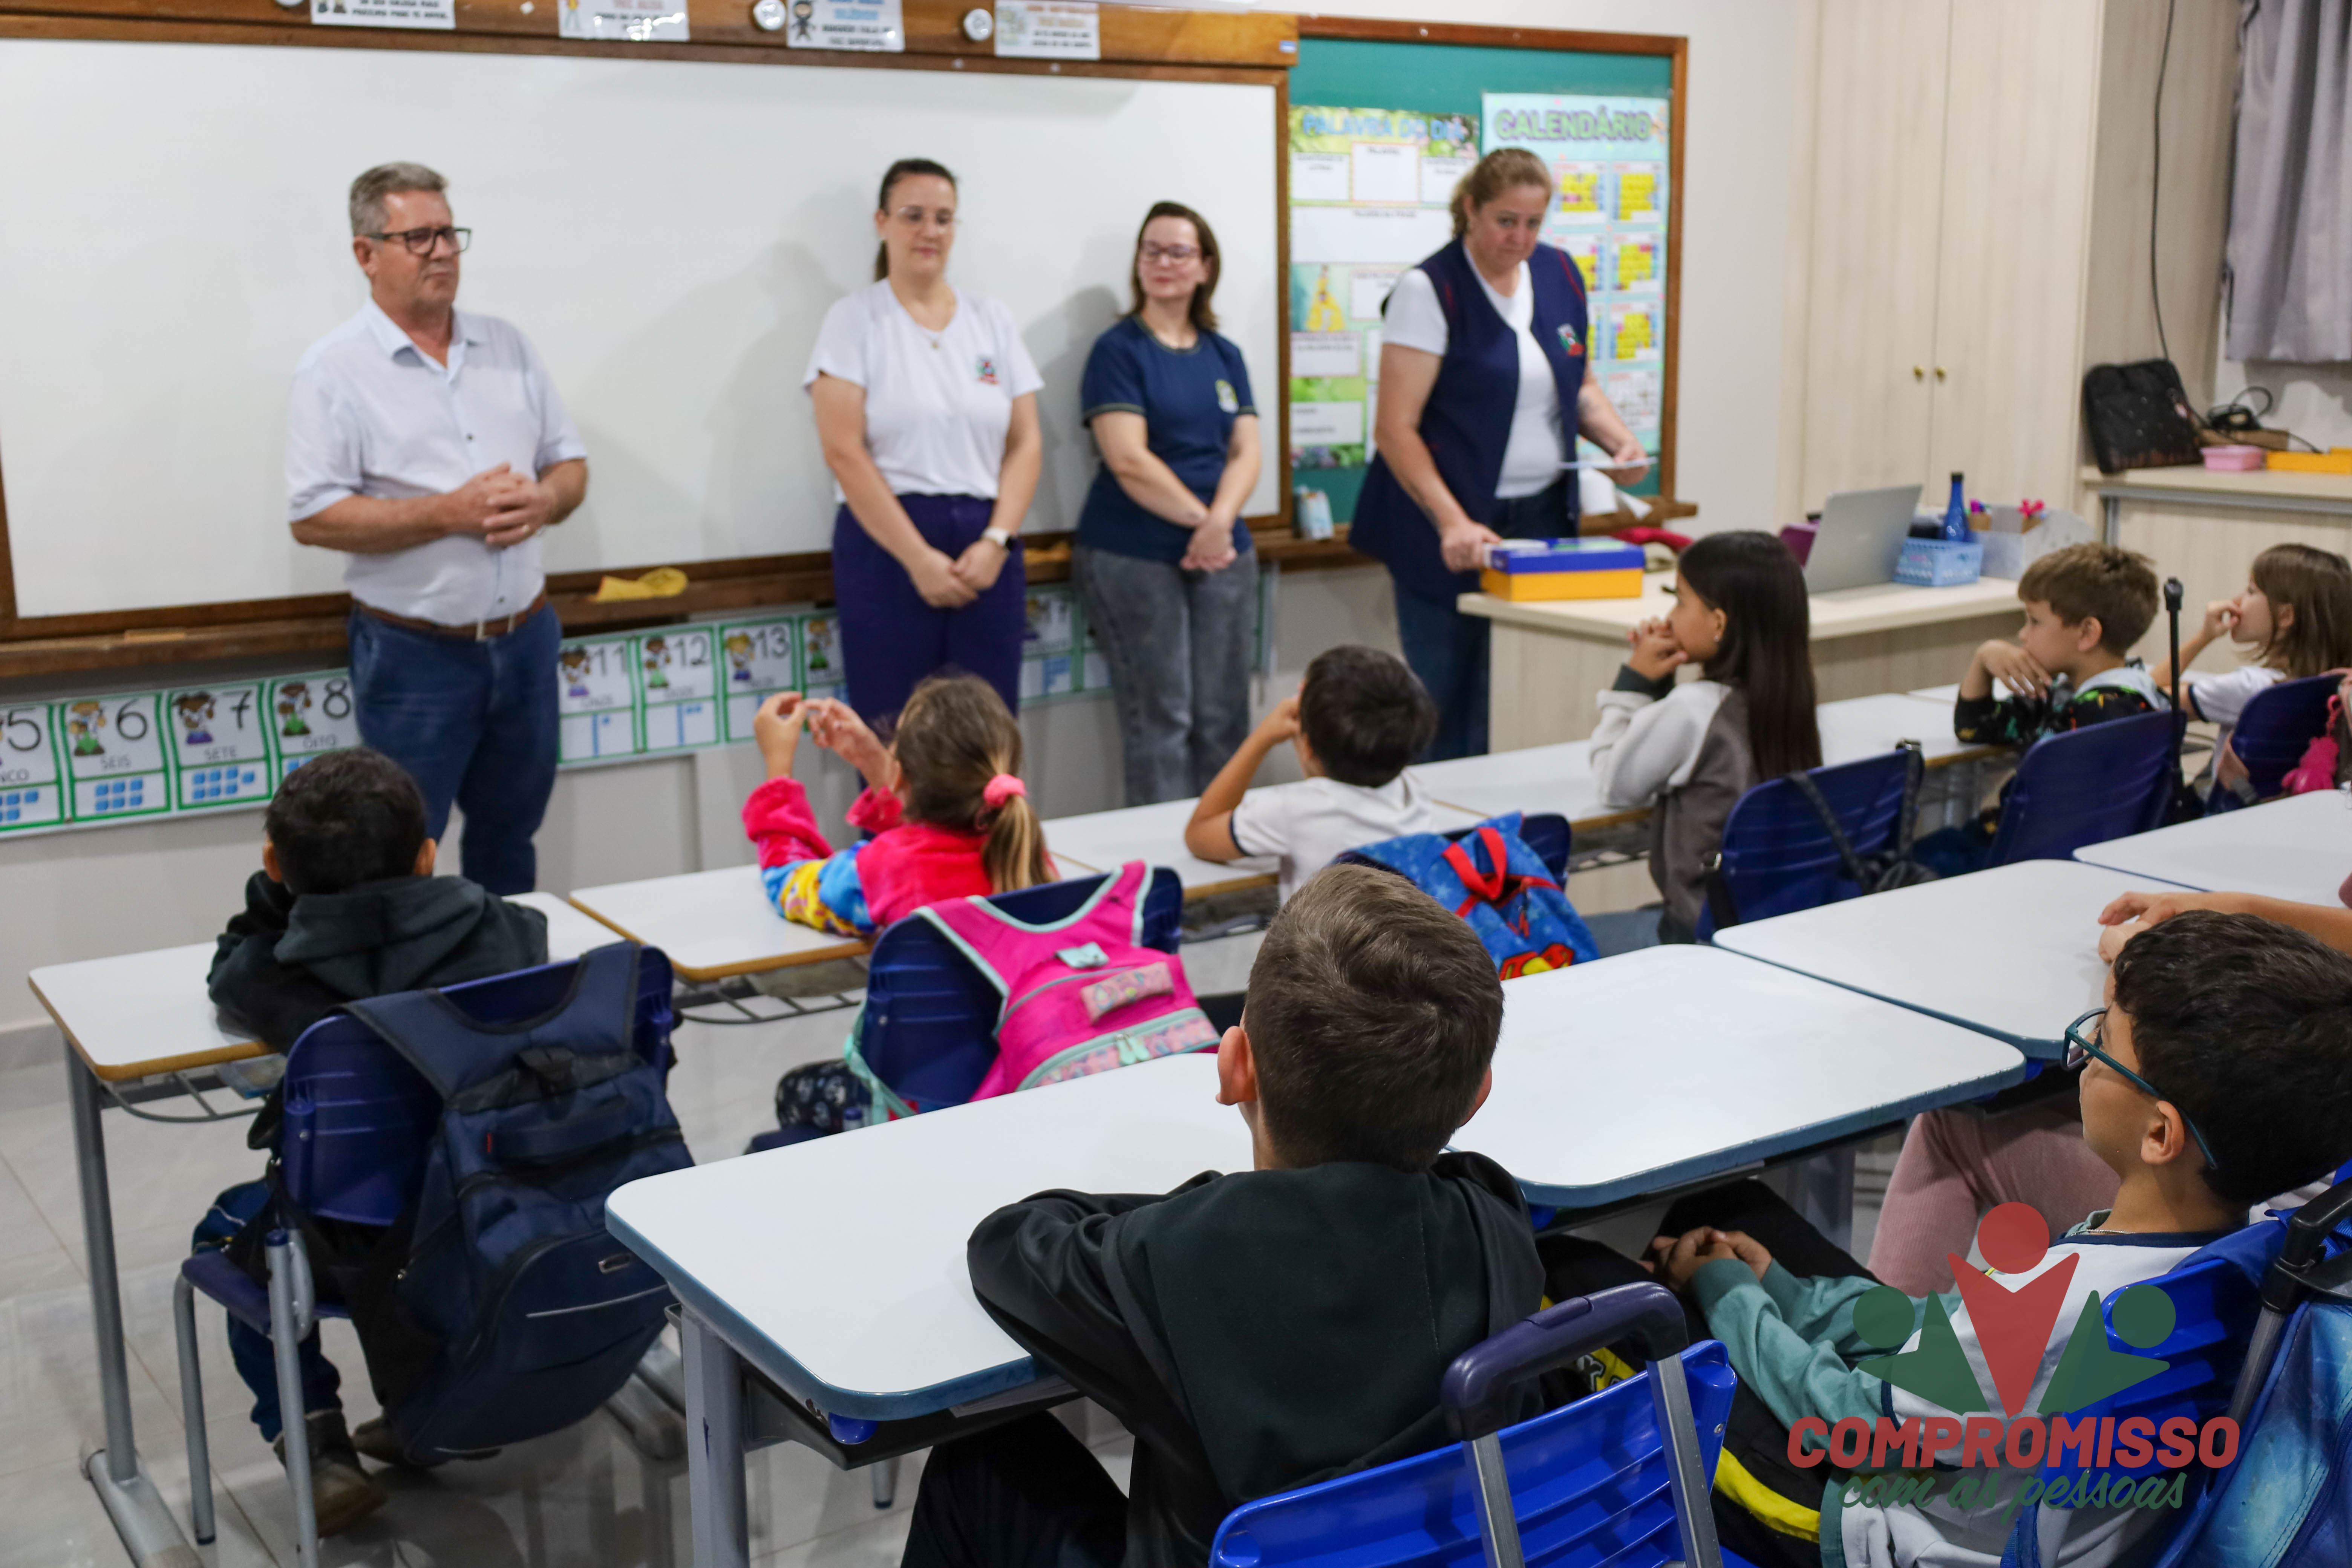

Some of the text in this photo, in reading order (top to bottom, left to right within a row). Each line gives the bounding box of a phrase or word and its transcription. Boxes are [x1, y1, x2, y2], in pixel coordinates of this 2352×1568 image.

[1303, 114, 1465, 141] PALAVRA DO DIA
[1494, 104, 1653, 141] CALENDÁRIO
[674, 635, 709, 668] 12
[755, 626, 791, 659] 13
[594, 645, 627, 677] 11
[222, 691, 251, 729] 7
[323, 678, 351, 720] 8
[8, 707, 41, 751] 5
[116, 698, 147, 741] 6
[204, 745, 237, 761] SETE
[303, 734, 337, 749] OITO
[100, 755, 131, 769] SEIS
